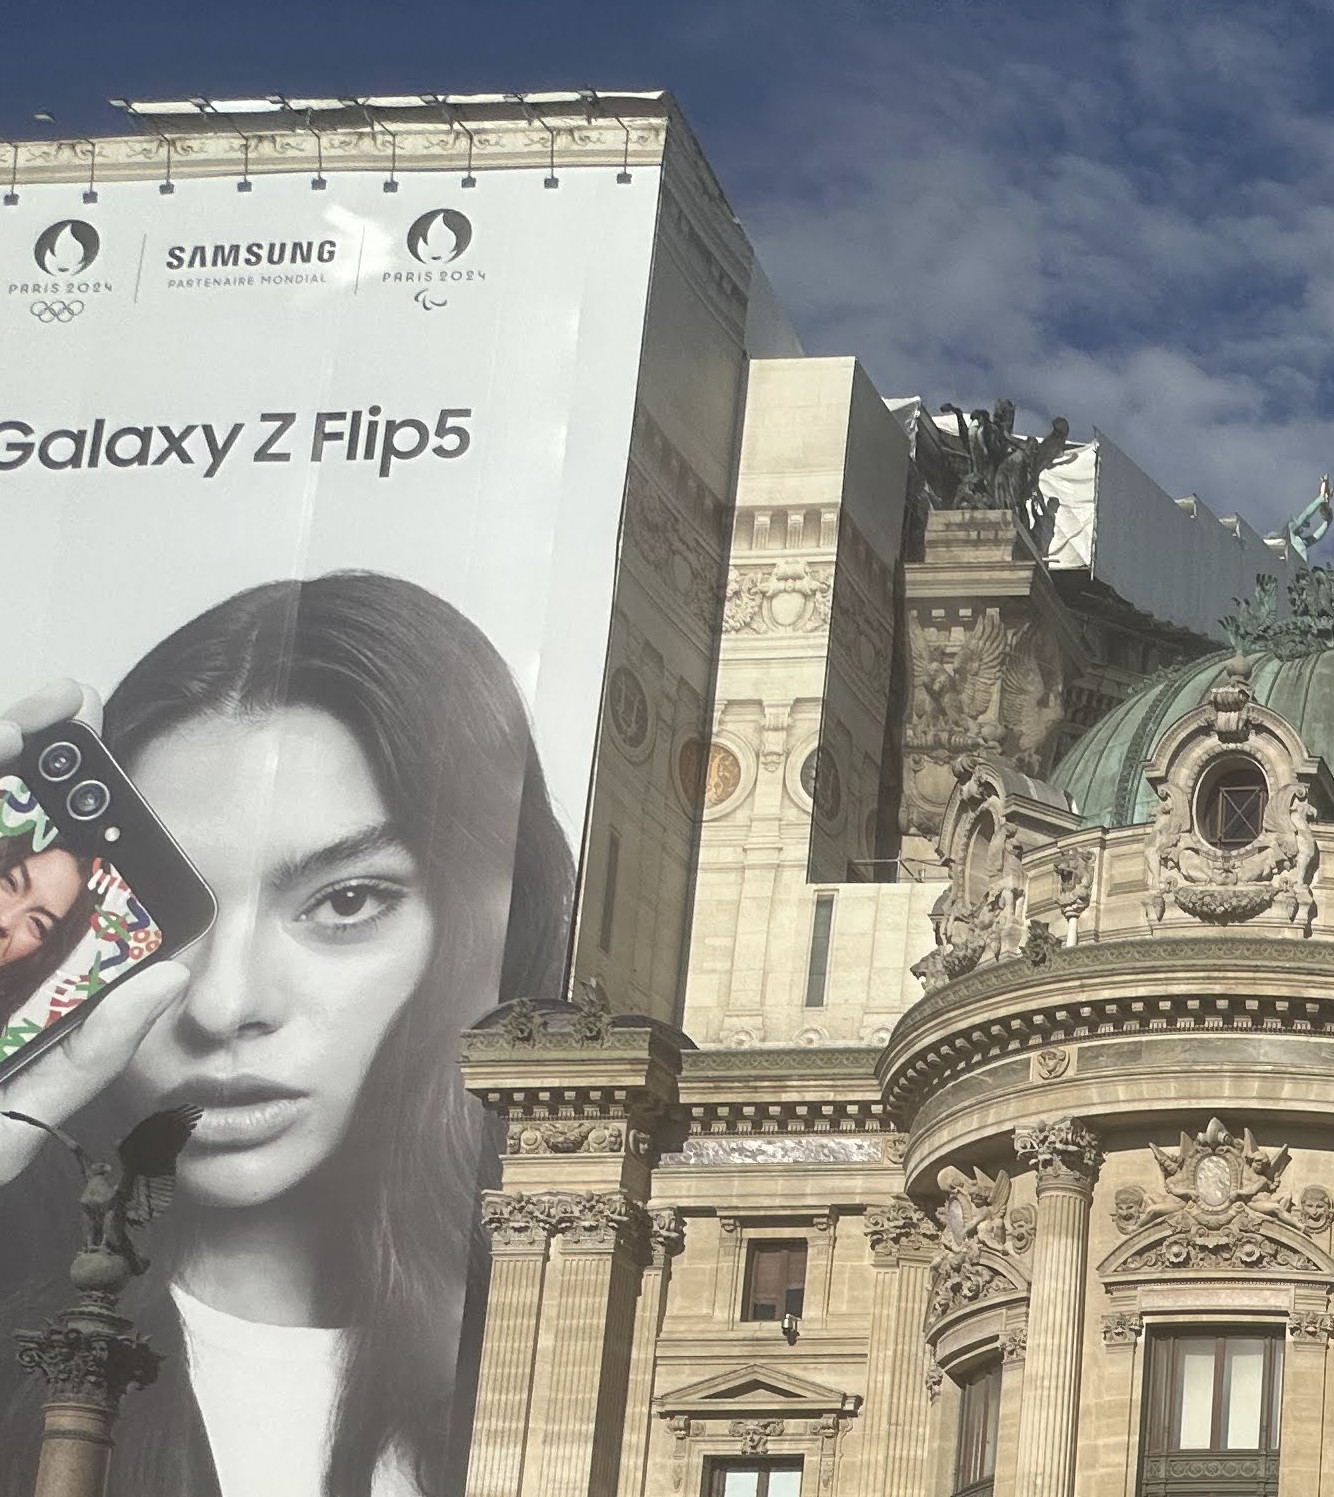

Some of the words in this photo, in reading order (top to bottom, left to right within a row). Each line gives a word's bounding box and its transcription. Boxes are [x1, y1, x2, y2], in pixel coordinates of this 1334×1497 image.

[166, 240, 337, 270] SAMSUNG
[167, 277, 255, 289] PARTENAIRE
[260, 273, 327, 286] MONDIAL
[382, 271, 432, 283] PARIS
[439, 270, 487, 282] 2024
[8, 283, 60, 295] PARIS
[66, 281, 113, 294] 2024
[0, 418, 245, 478] Galaxy
[253, 412, 297, 463] Z
[310, 404, 473, 478] Flip5
